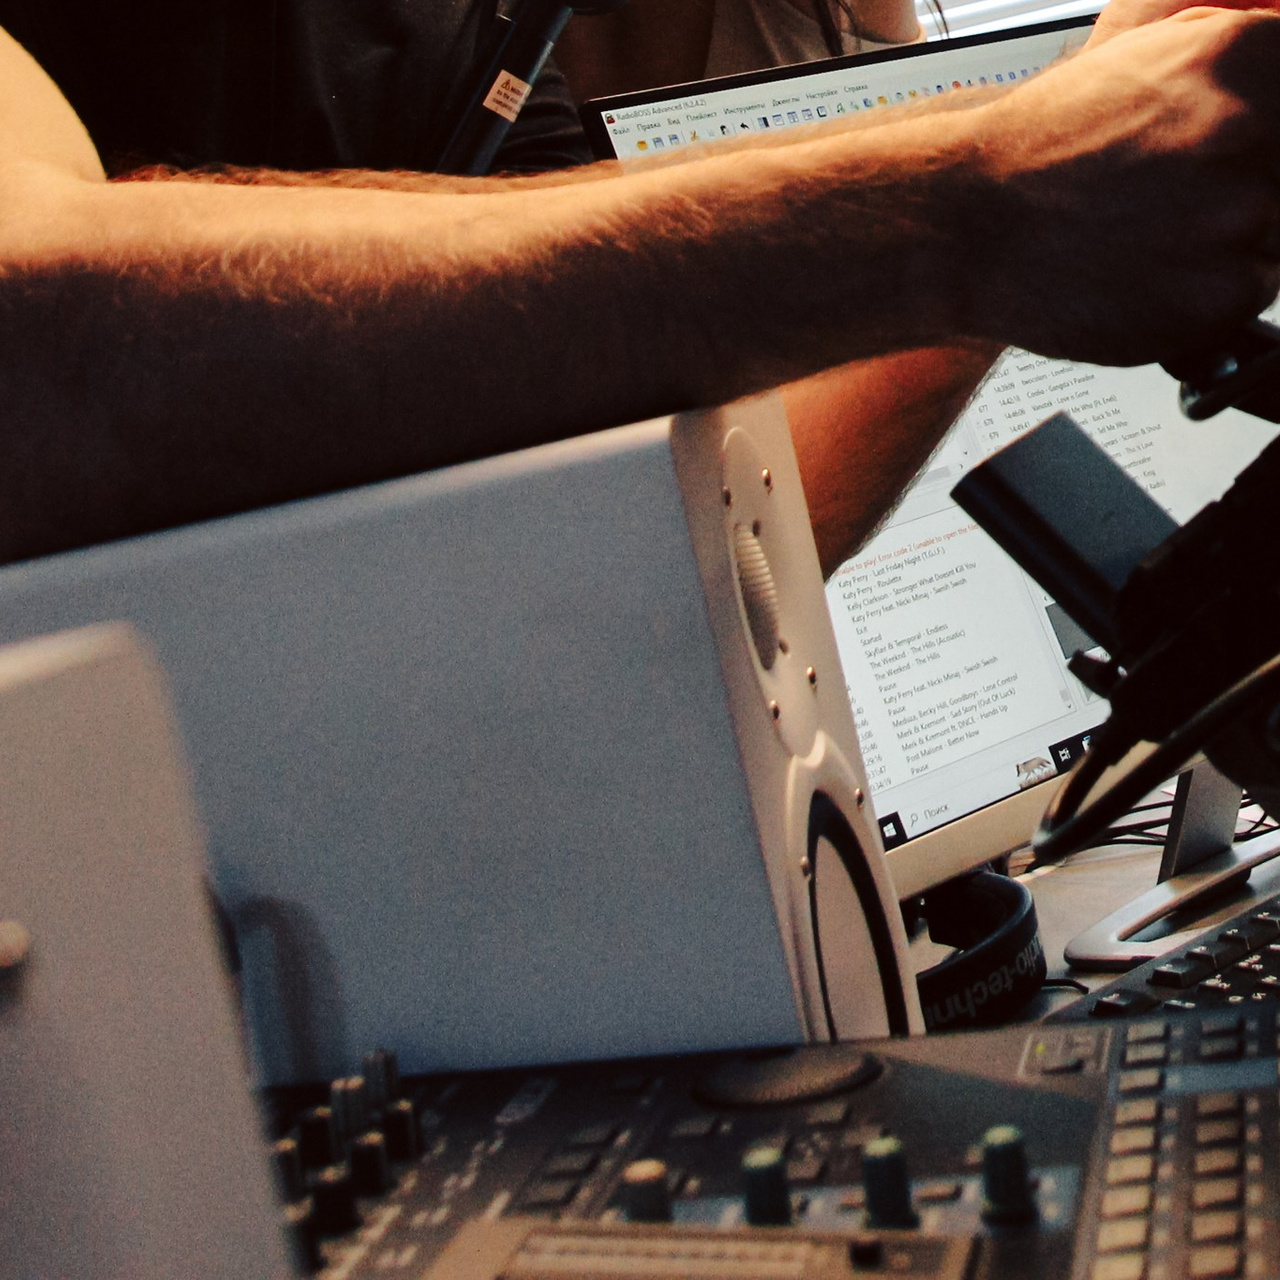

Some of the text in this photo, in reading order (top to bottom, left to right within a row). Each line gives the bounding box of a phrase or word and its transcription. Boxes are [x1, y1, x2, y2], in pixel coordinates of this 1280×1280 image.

[617, 109, 651, 120] RadioBOSS
[652, 104, 682, 114] Advanced
[838, 580, 852, 588] Katy
[852, 575, 868, 583] Perry
[872, 568, 885, 577] Last
[885, 562, 904, 572] Friday
[904, 555, 921, 565] Night
[878, 683, 897, 692] Pause
[888, 706, 905, 716] Pause
[923, 803, 949, 820] Поиск
